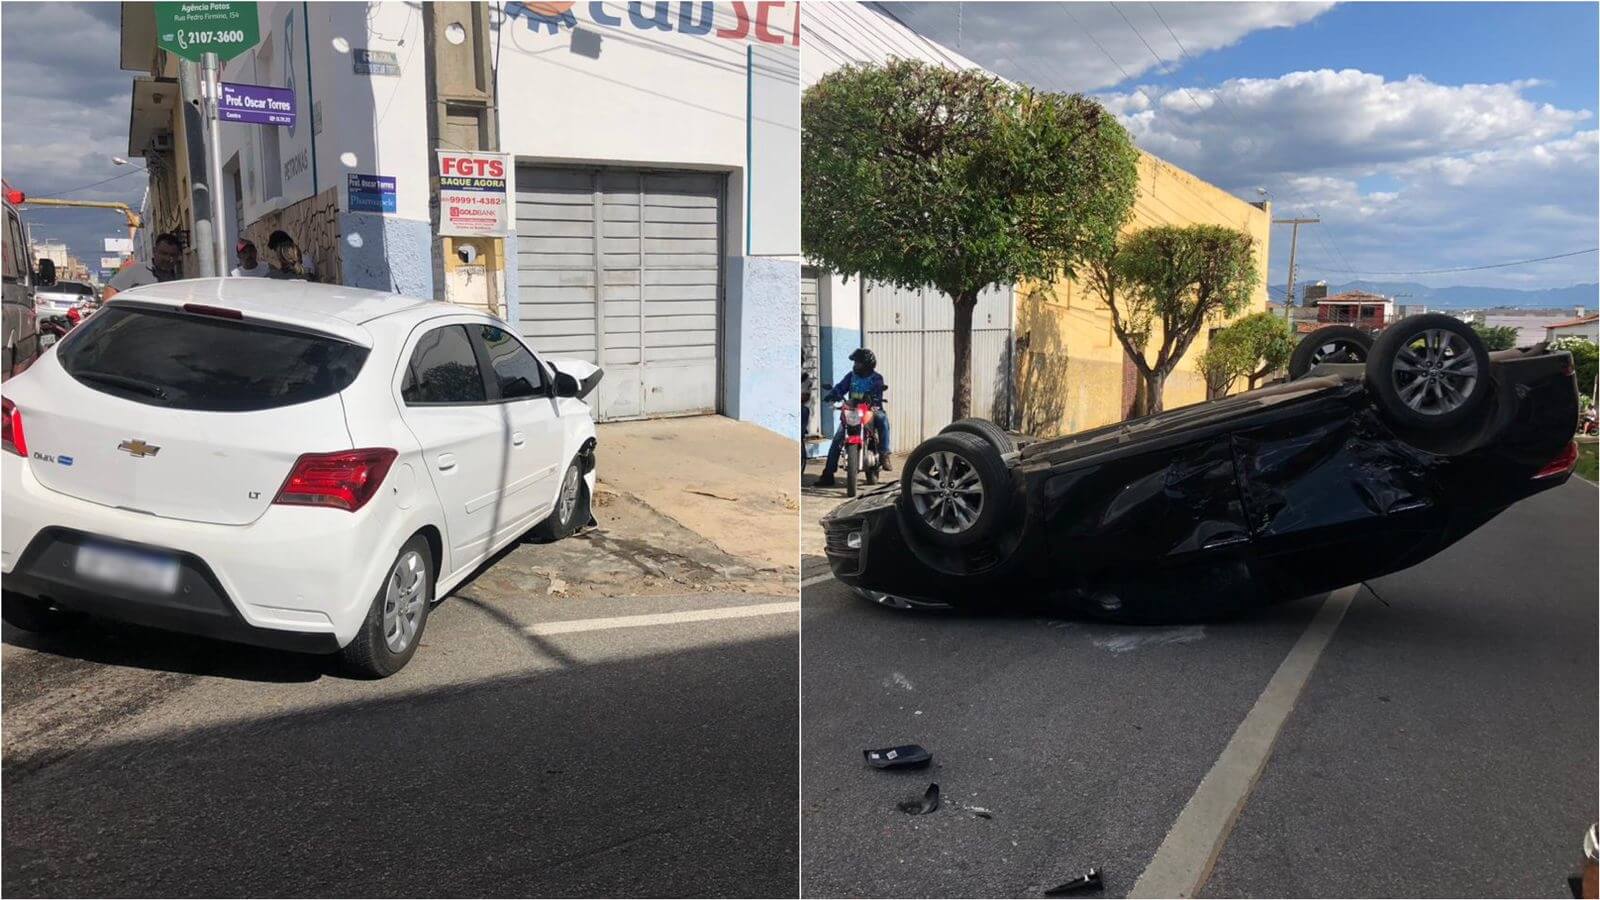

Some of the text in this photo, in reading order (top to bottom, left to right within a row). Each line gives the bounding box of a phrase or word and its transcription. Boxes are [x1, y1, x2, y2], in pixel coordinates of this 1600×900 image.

[181, 4, 208, 13] Agência
[188, 30, 244, 44] 2107-3600
[226, 94, 291, 111] Prof. Oscar Torres
[442, 157, 504, 177] FGTS
[440, 177, 505, 187] SAQUE AGORA
[248, 491, 261, 499] LT
